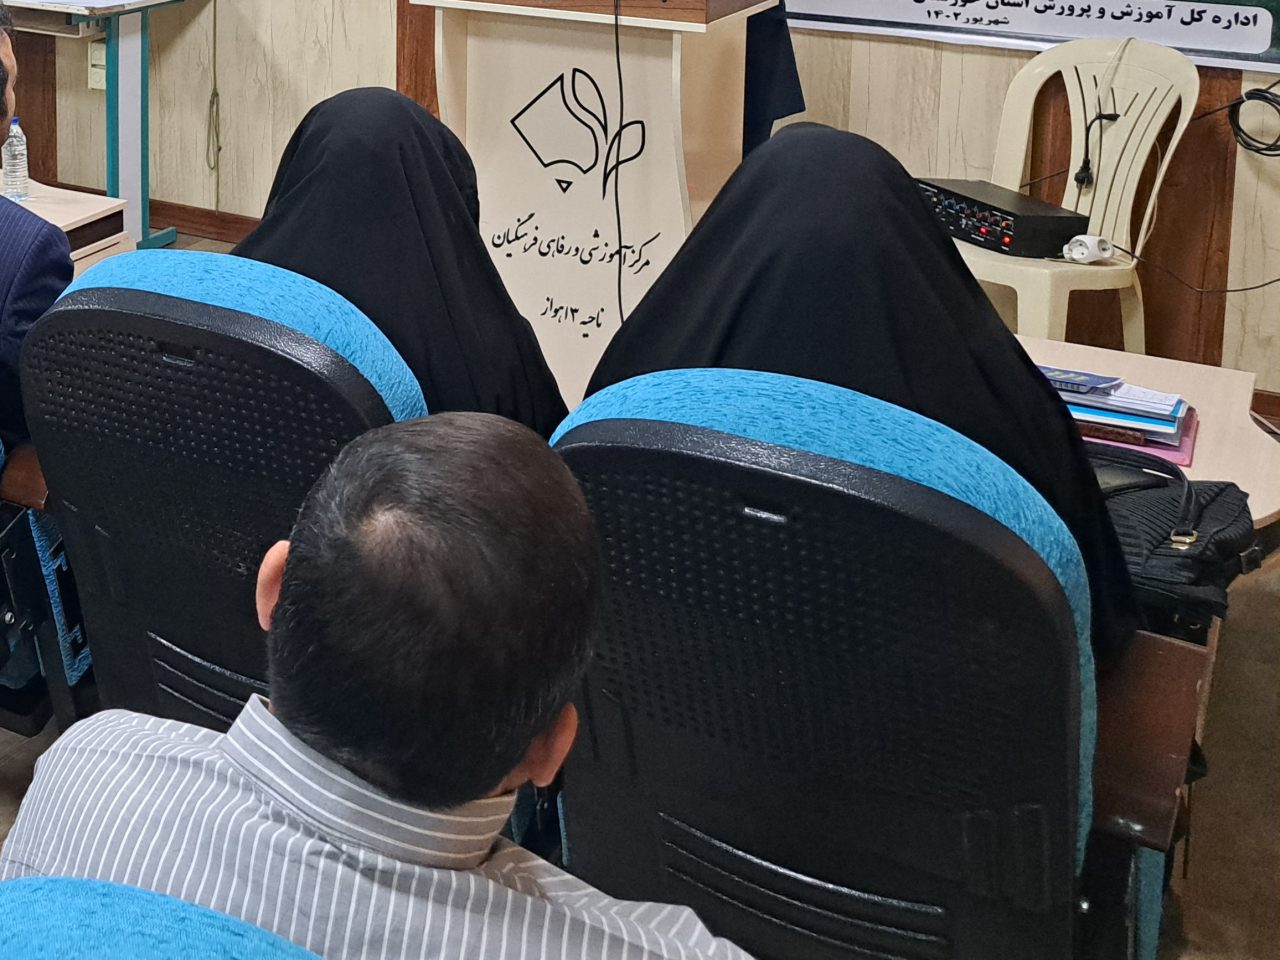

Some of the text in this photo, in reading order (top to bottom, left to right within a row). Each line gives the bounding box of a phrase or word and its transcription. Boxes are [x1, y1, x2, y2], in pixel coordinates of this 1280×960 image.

[1095, 6, 1107, 19] و
[1110, 4, 1177, 24] آموزش
[1179, 8, 1208, 26] کل
[1211, 12, 1259, 30] اداره
[491, 212, 539, 258] فرهنگیان
[628, 231, 662, 275] مرکز
[540, 296, 604, 339] ناحیه ۳ اهواز
